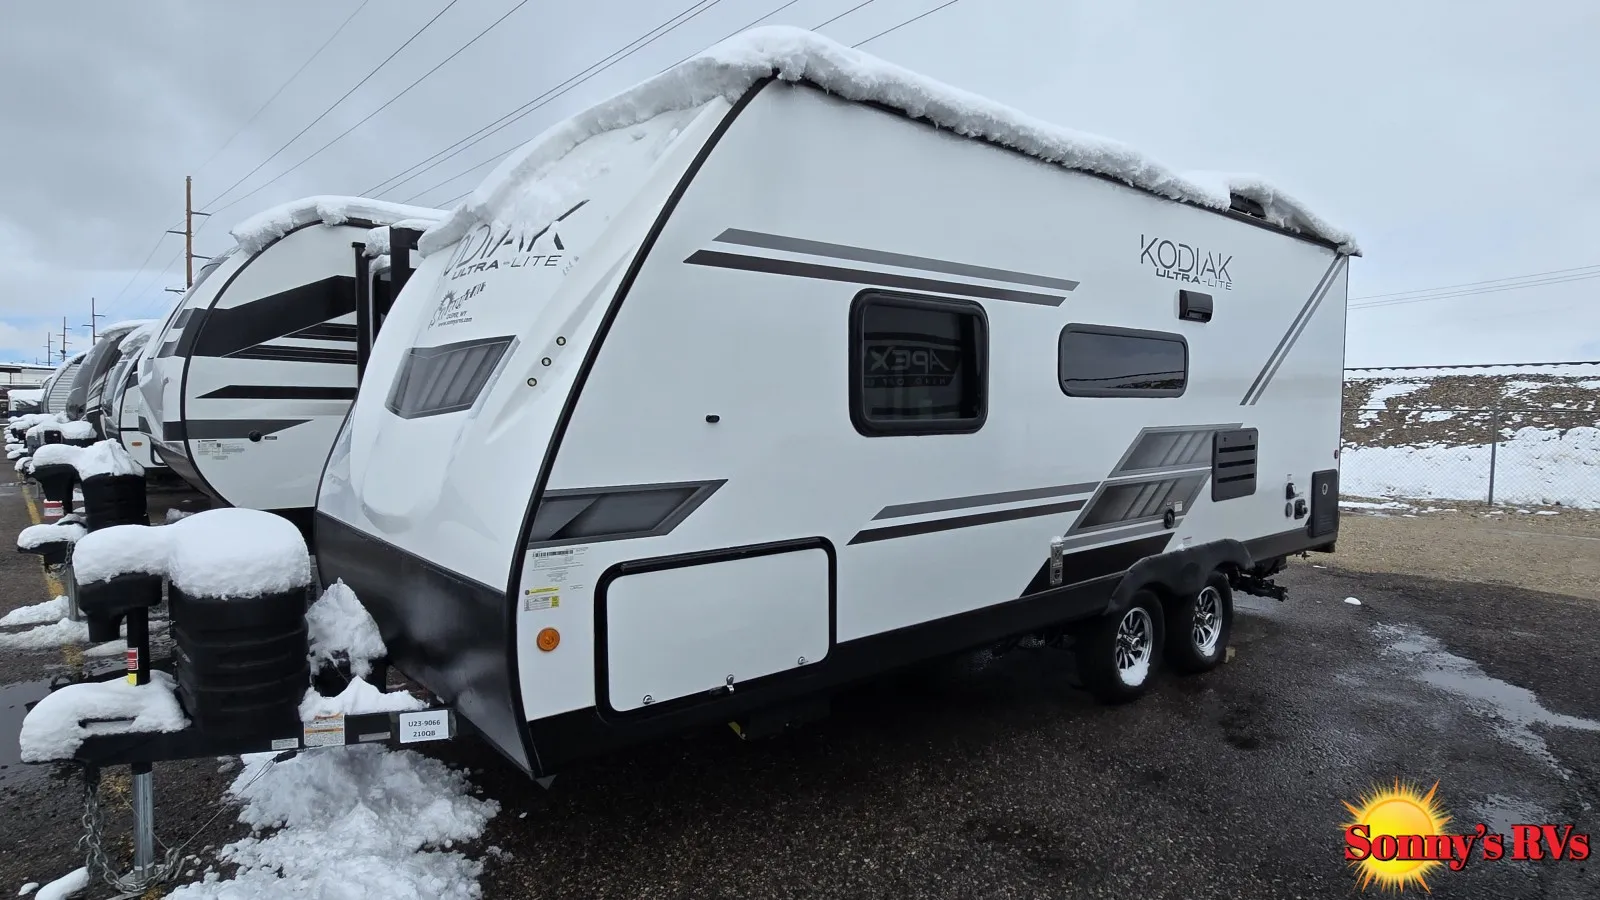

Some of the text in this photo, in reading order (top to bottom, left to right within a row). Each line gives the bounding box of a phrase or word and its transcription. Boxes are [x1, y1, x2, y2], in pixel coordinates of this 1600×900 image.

[443, 199, 590, 277] ODIAK
[451, 254, 562, 280] ULTRA-LITE
[1140, 233, 1233, 282] KODIAK
[1155, 267, 1233, 291] ULTRA-LITE
[408, 719, 441, 728] U23-9066
[412, 730, 436, 738] 210QB
